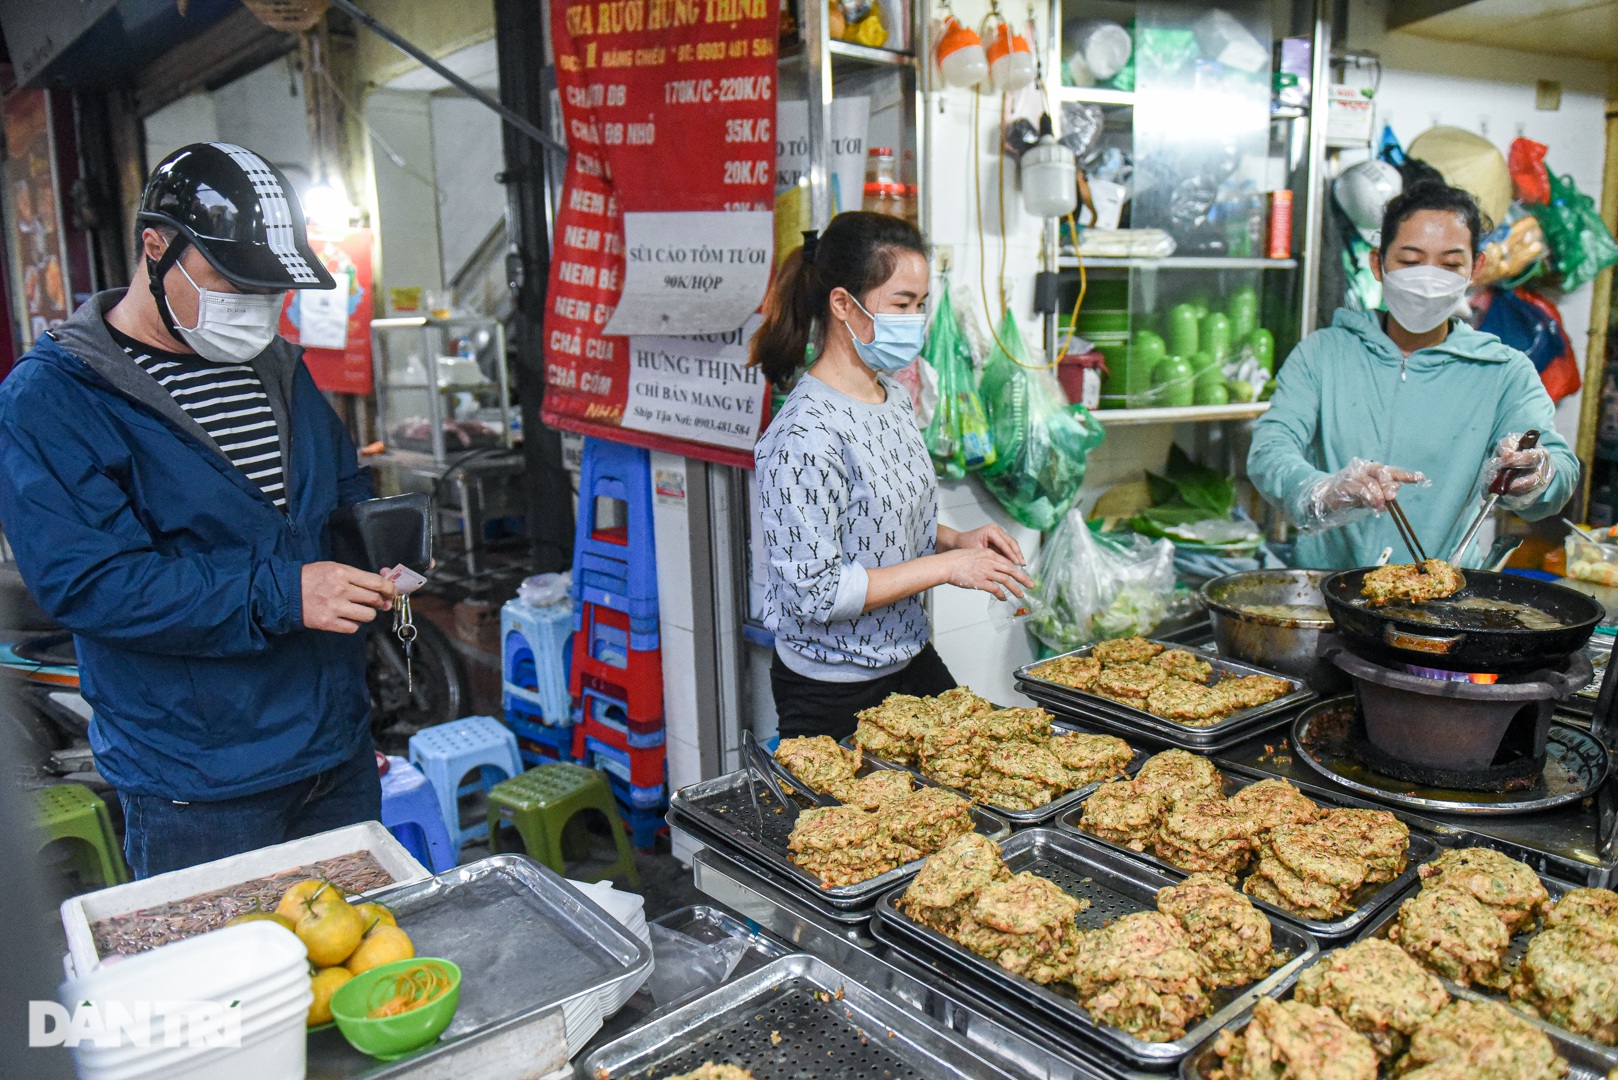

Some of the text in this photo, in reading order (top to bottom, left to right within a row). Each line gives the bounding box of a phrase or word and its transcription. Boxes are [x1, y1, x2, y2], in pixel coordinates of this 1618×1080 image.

[725, 118, 771, 143] 35K/C
[724, 160, 769, 184] 20K/C
[570, 188, 605, 215] NEM
[564, 225, 600, 251] NEM
[690, 244, 724, 263] TÔM
[559, 261, 595, 287] NEM
[555, 296, 591, 322] NEM
[550, 327, 614, 361] CHẢ CUA
[636, 349, 758, 385] HƯNG THỊNH
[662, 383, 688, 402] BÁN
[691, 390, 732, 411] MANG
[633, 405, 653, 420] Ship
